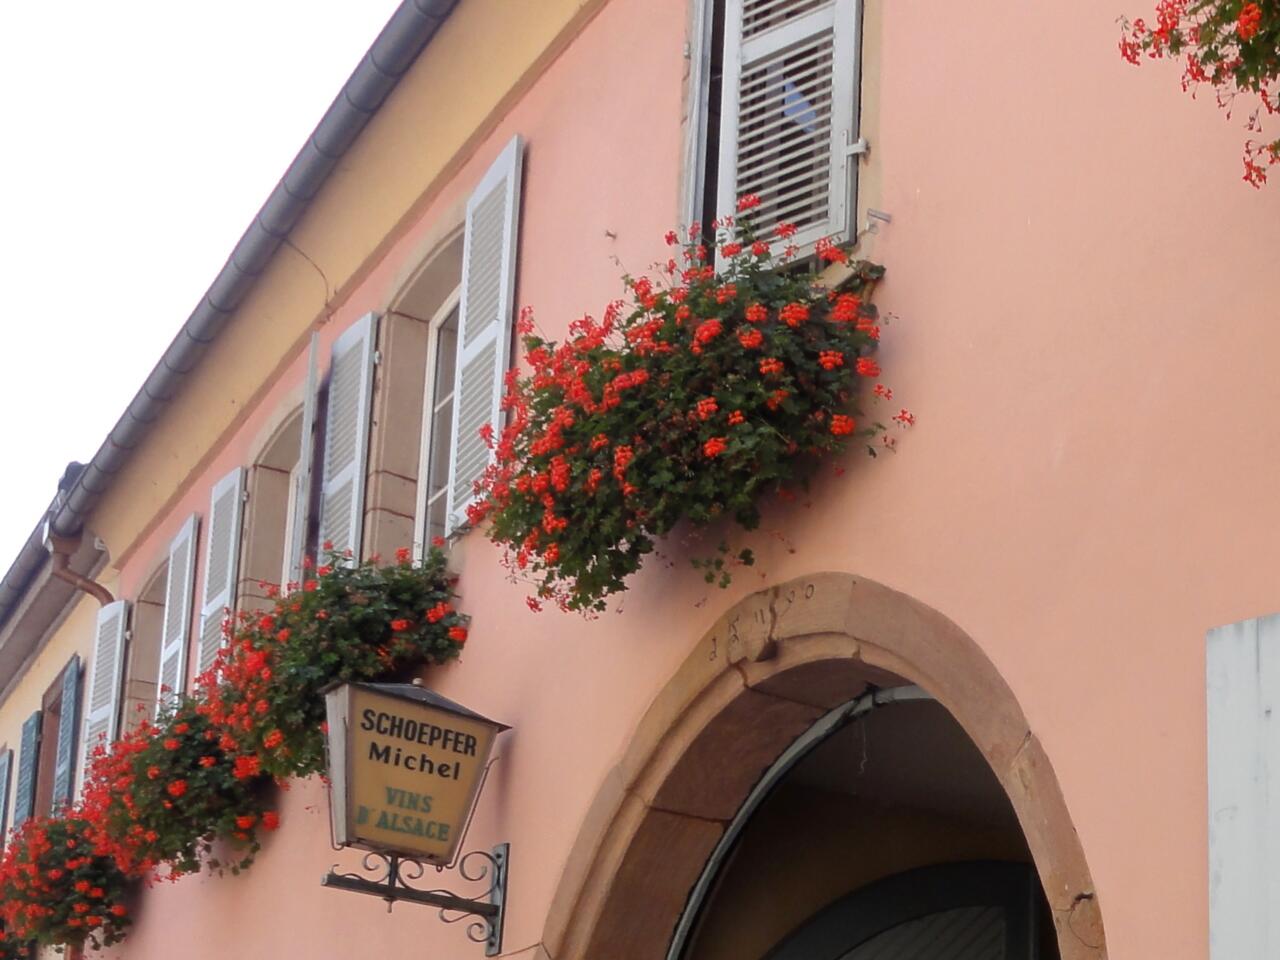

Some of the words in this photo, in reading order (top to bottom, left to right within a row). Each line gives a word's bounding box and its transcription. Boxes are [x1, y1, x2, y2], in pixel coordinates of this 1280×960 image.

[361, 708, 477, 757] SCHOEPFER
[368, 742, 461, 780] Michel
[385, 786, 433, 813] VINS
